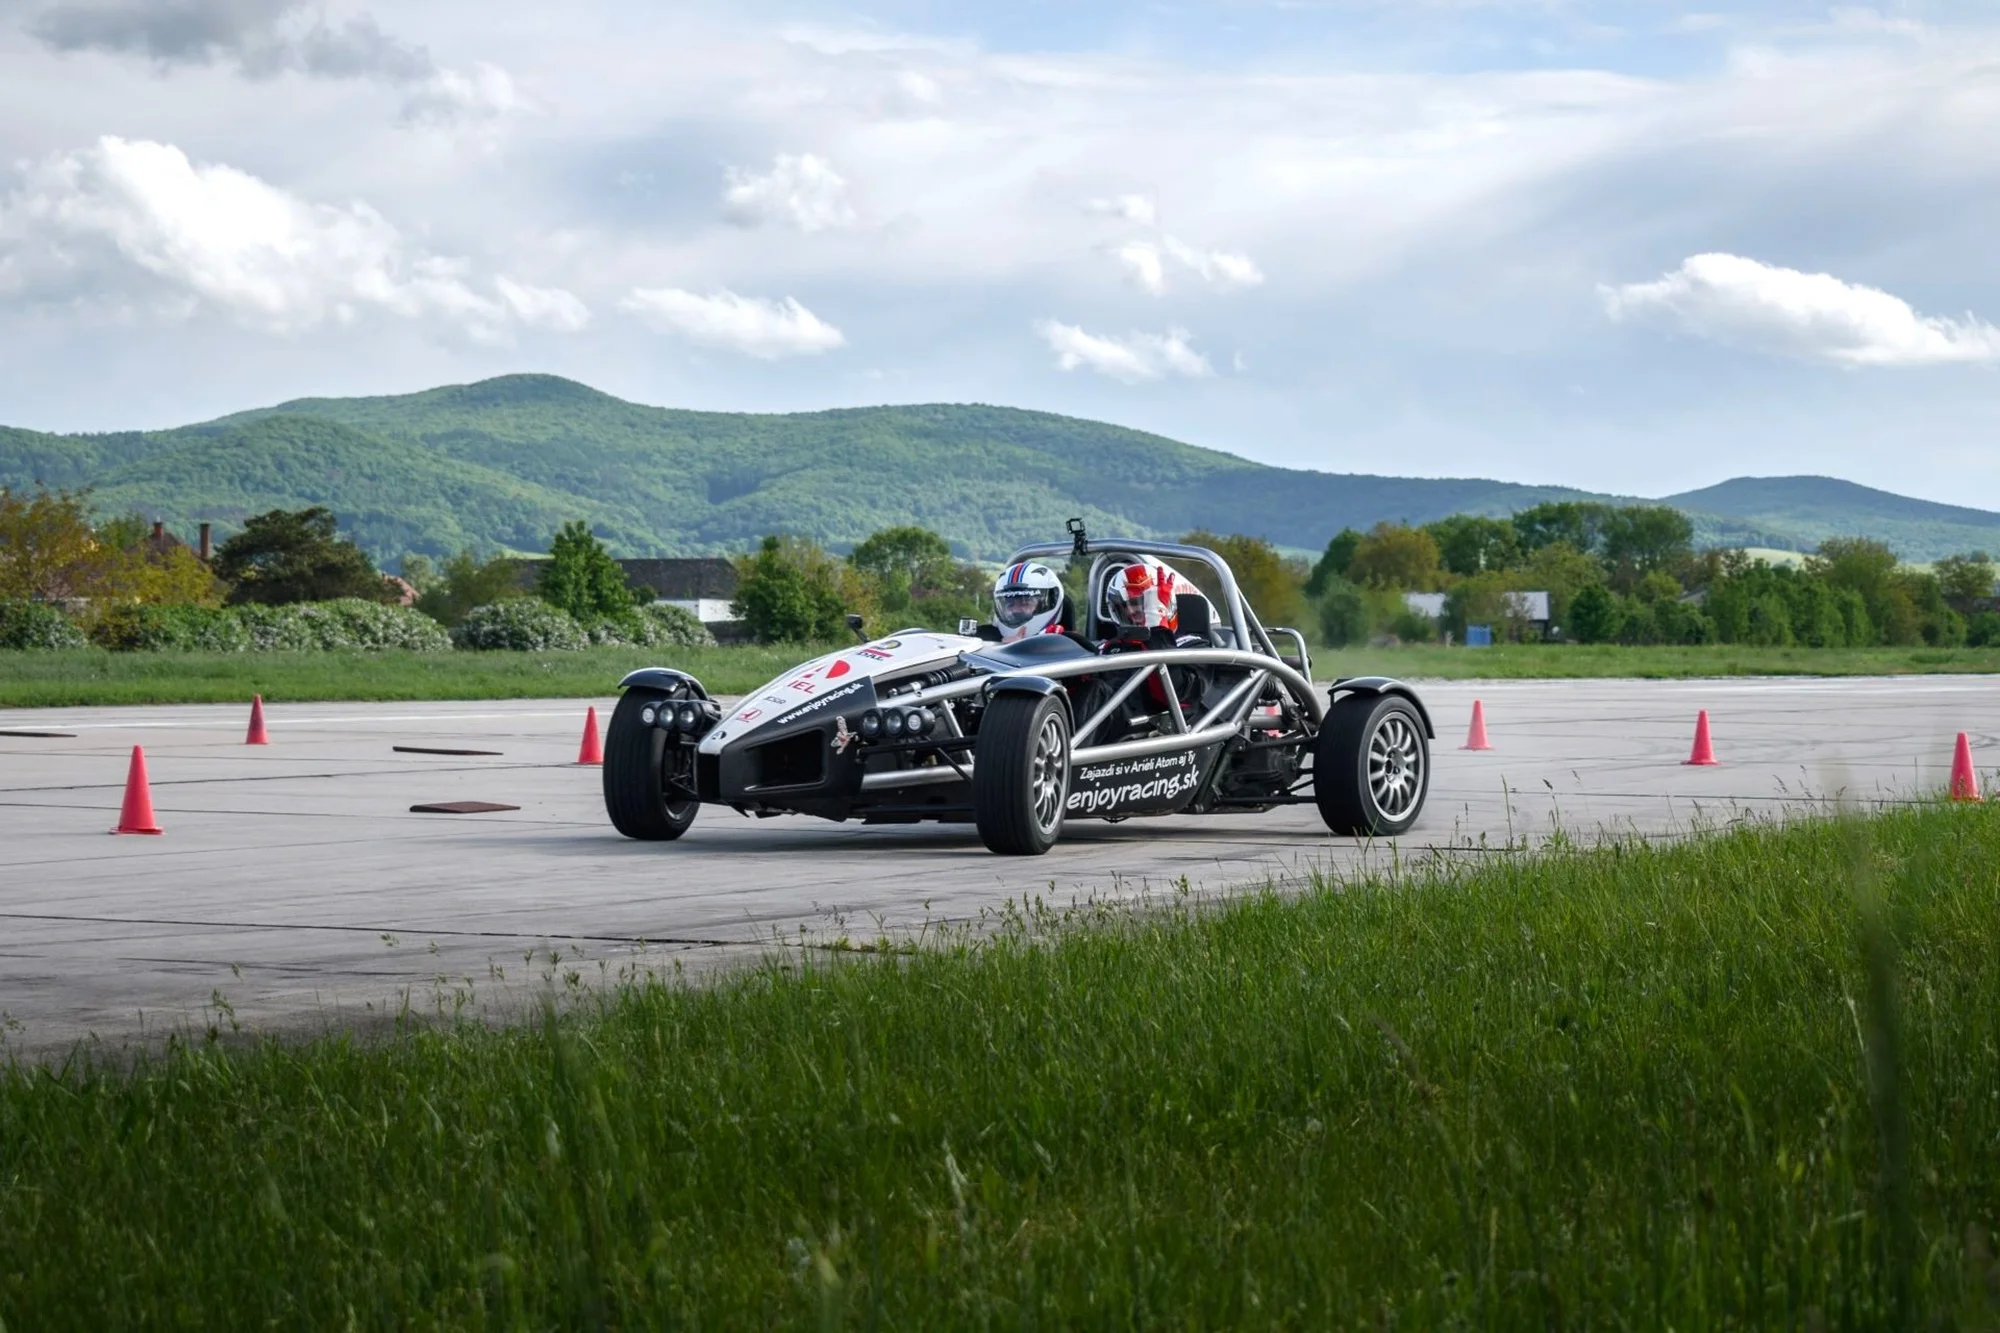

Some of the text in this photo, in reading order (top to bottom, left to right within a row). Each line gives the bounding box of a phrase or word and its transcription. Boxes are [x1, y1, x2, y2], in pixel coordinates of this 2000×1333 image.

[777, 683, 864, 724] www.enjoyracing.sk
[1080, 764, 1115, 781] Zajazdi
[1115, 763, 1124, 775] si
[1124, 765, 1131, 774] v
[1155, 757, 1178, 769] Atom
[1178, 752, 1188, 766] aj
[1067, 764, 1199, 812] enjoyracing.sk
